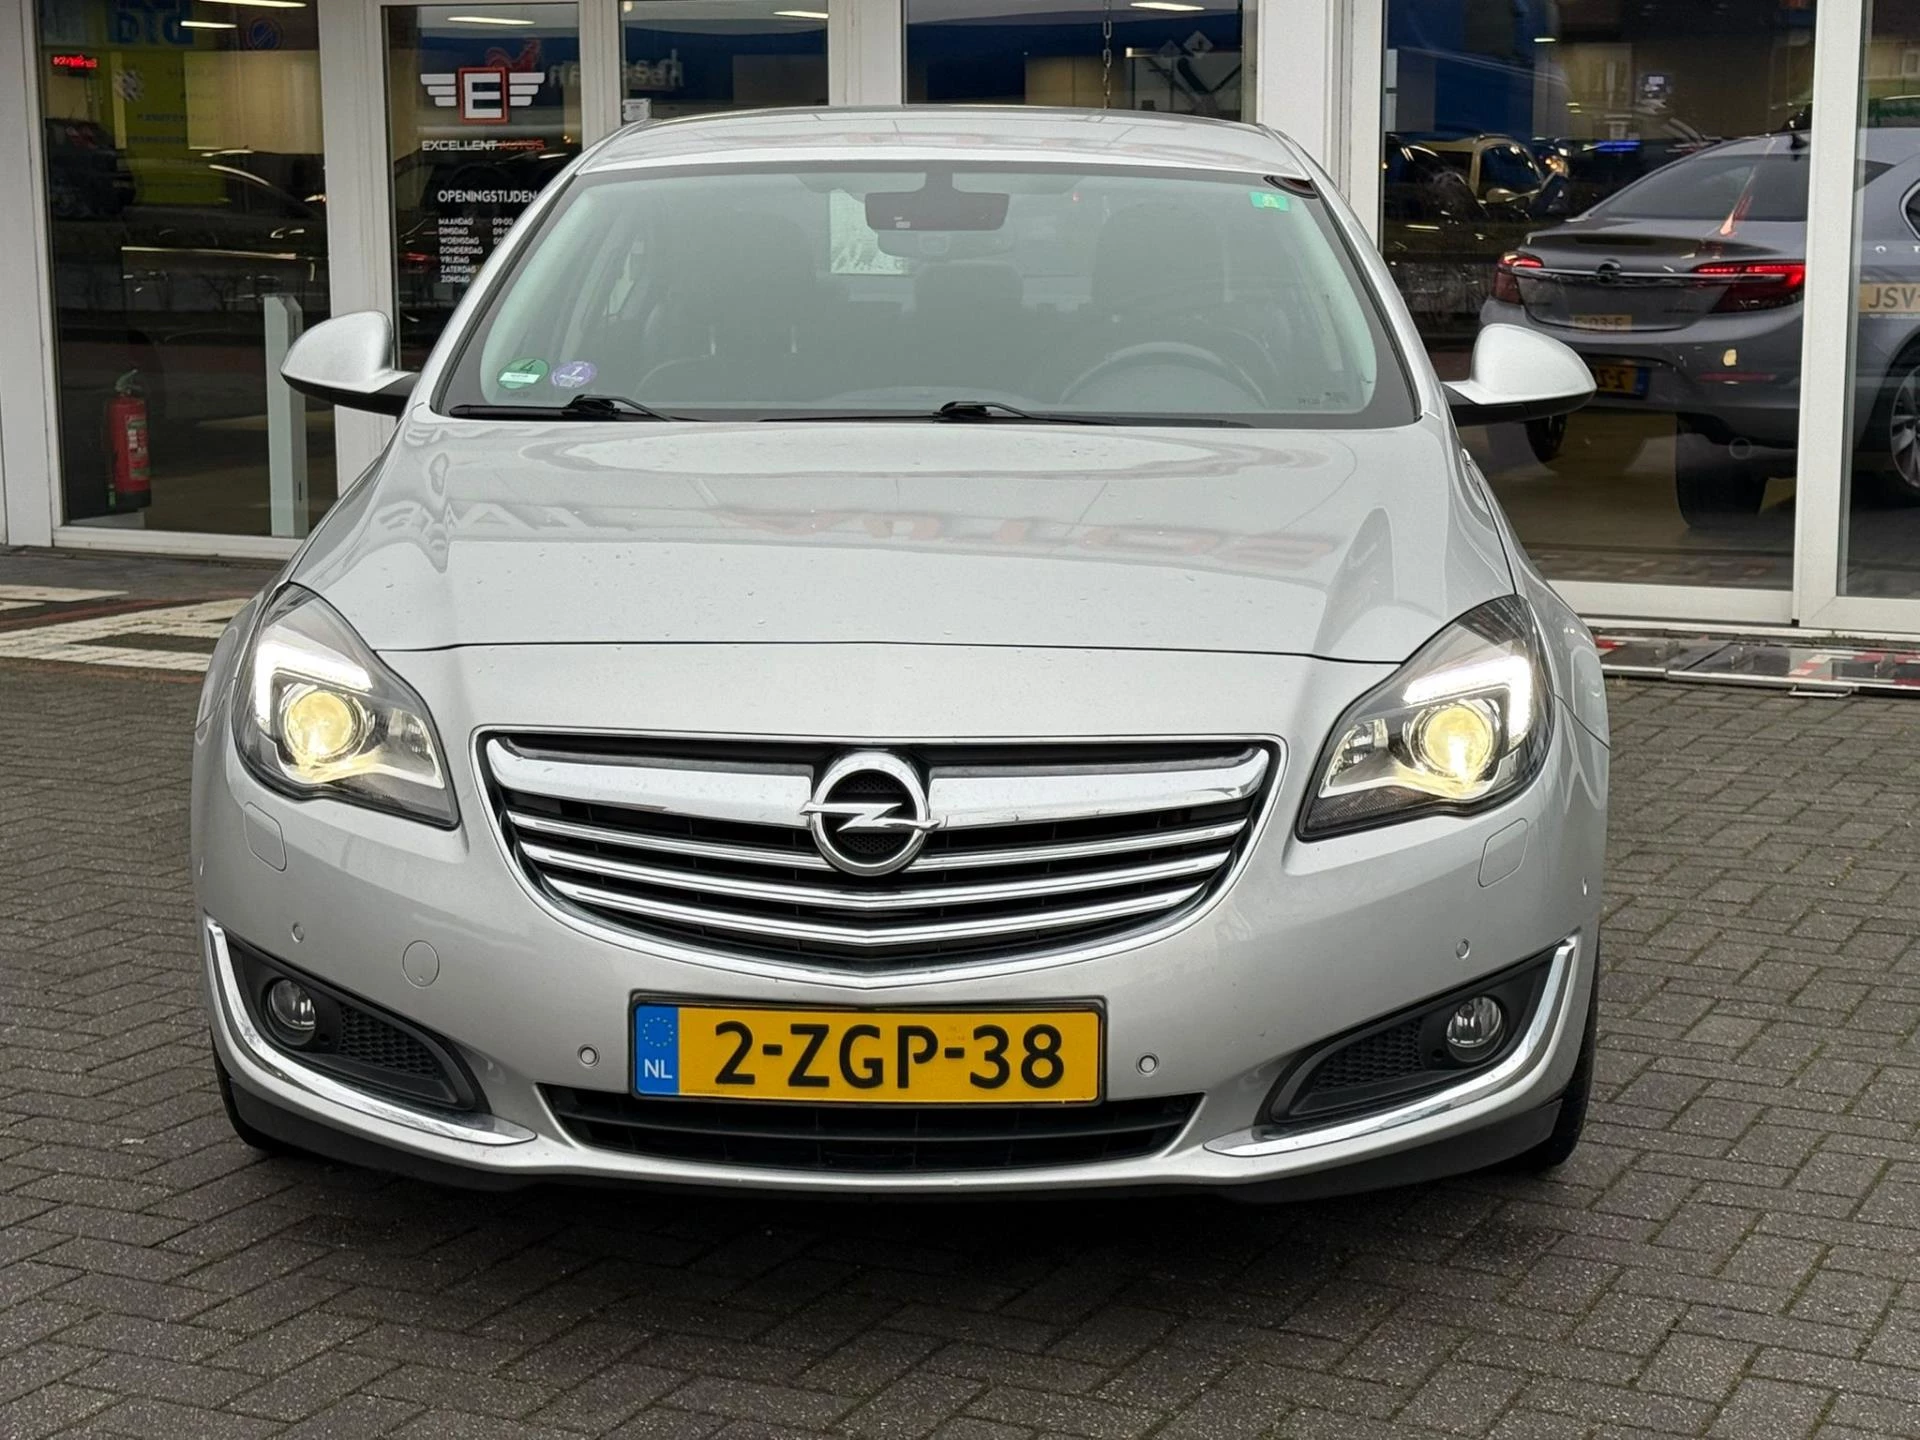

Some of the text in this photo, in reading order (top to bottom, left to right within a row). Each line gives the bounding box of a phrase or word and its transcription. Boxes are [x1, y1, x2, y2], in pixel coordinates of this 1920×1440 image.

[464, 72, 502, 119] E
[422, 140, 497, 151] EXCELLENT
[437, 190, 538, 203] OPENINGSTIJDEN
[438, 217, 474, 226] MAANDAG
[439, 227, 469, 235] DINSDAG
[440, 237, 480, 245] WOENSDAG
[440, 246, 484, 255] DONDERDAG
[440, 256, 471, 264] VRIJDAG
[441, 265, 477, 274] ZATERDAG
[714, 1020, 1066, 1090] 2-ZGP-38
[644, 1058, 673, 1079] NL
